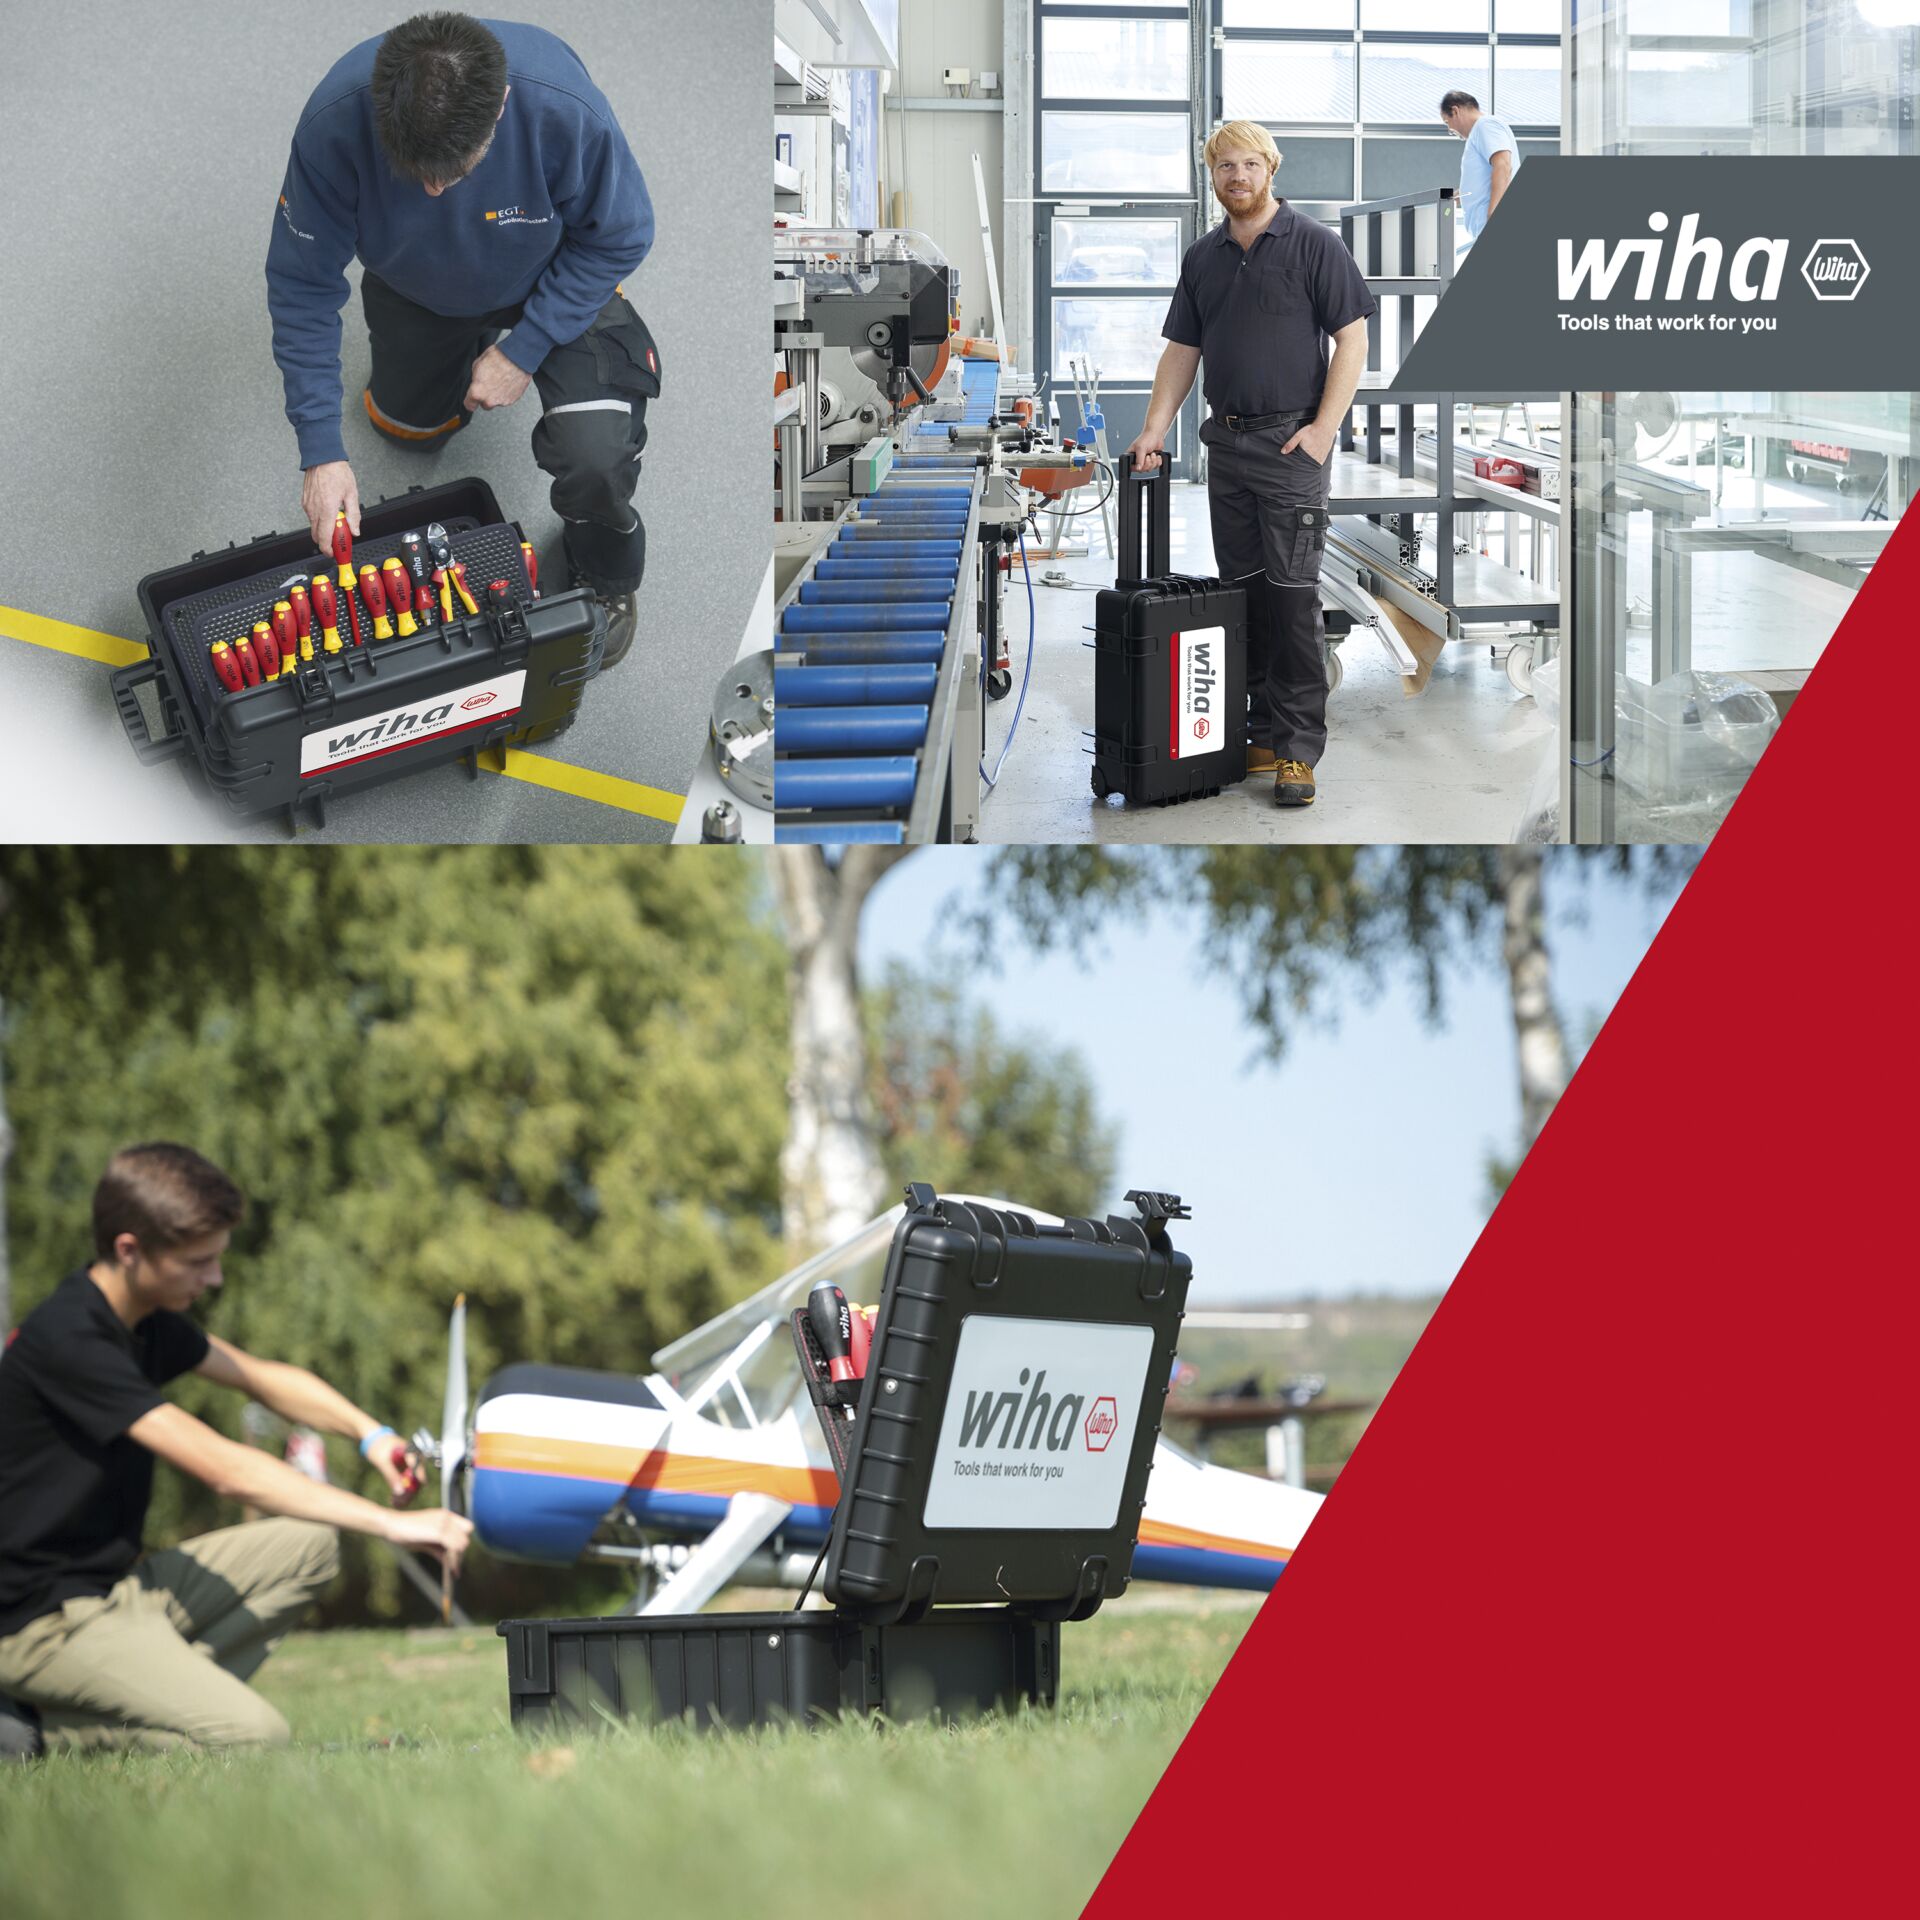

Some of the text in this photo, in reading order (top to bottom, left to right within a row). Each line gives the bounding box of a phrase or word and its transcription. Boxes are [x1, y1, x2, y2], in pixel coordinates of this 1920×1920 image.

[498, 206, 520, 218] EGT
[413, 556, 424, 577] wiha
[322, 598, 332, 617] wiha
[264, 645, 274, 664] wiha
[226, 663, 238, 682] wiha
[1194, 642, 1216, 714] wiha
[329, 703, 455, 753] wiha
[328, 720, 446, 759] Tools that work for you
[840, 1306, 850, 1339] wiha
[958, 1367, 1085, 1452] wiha
[1089, 1413, 1113, 1434] Wiha
[953, 1460, 1064, 1481] Tools that work for you
